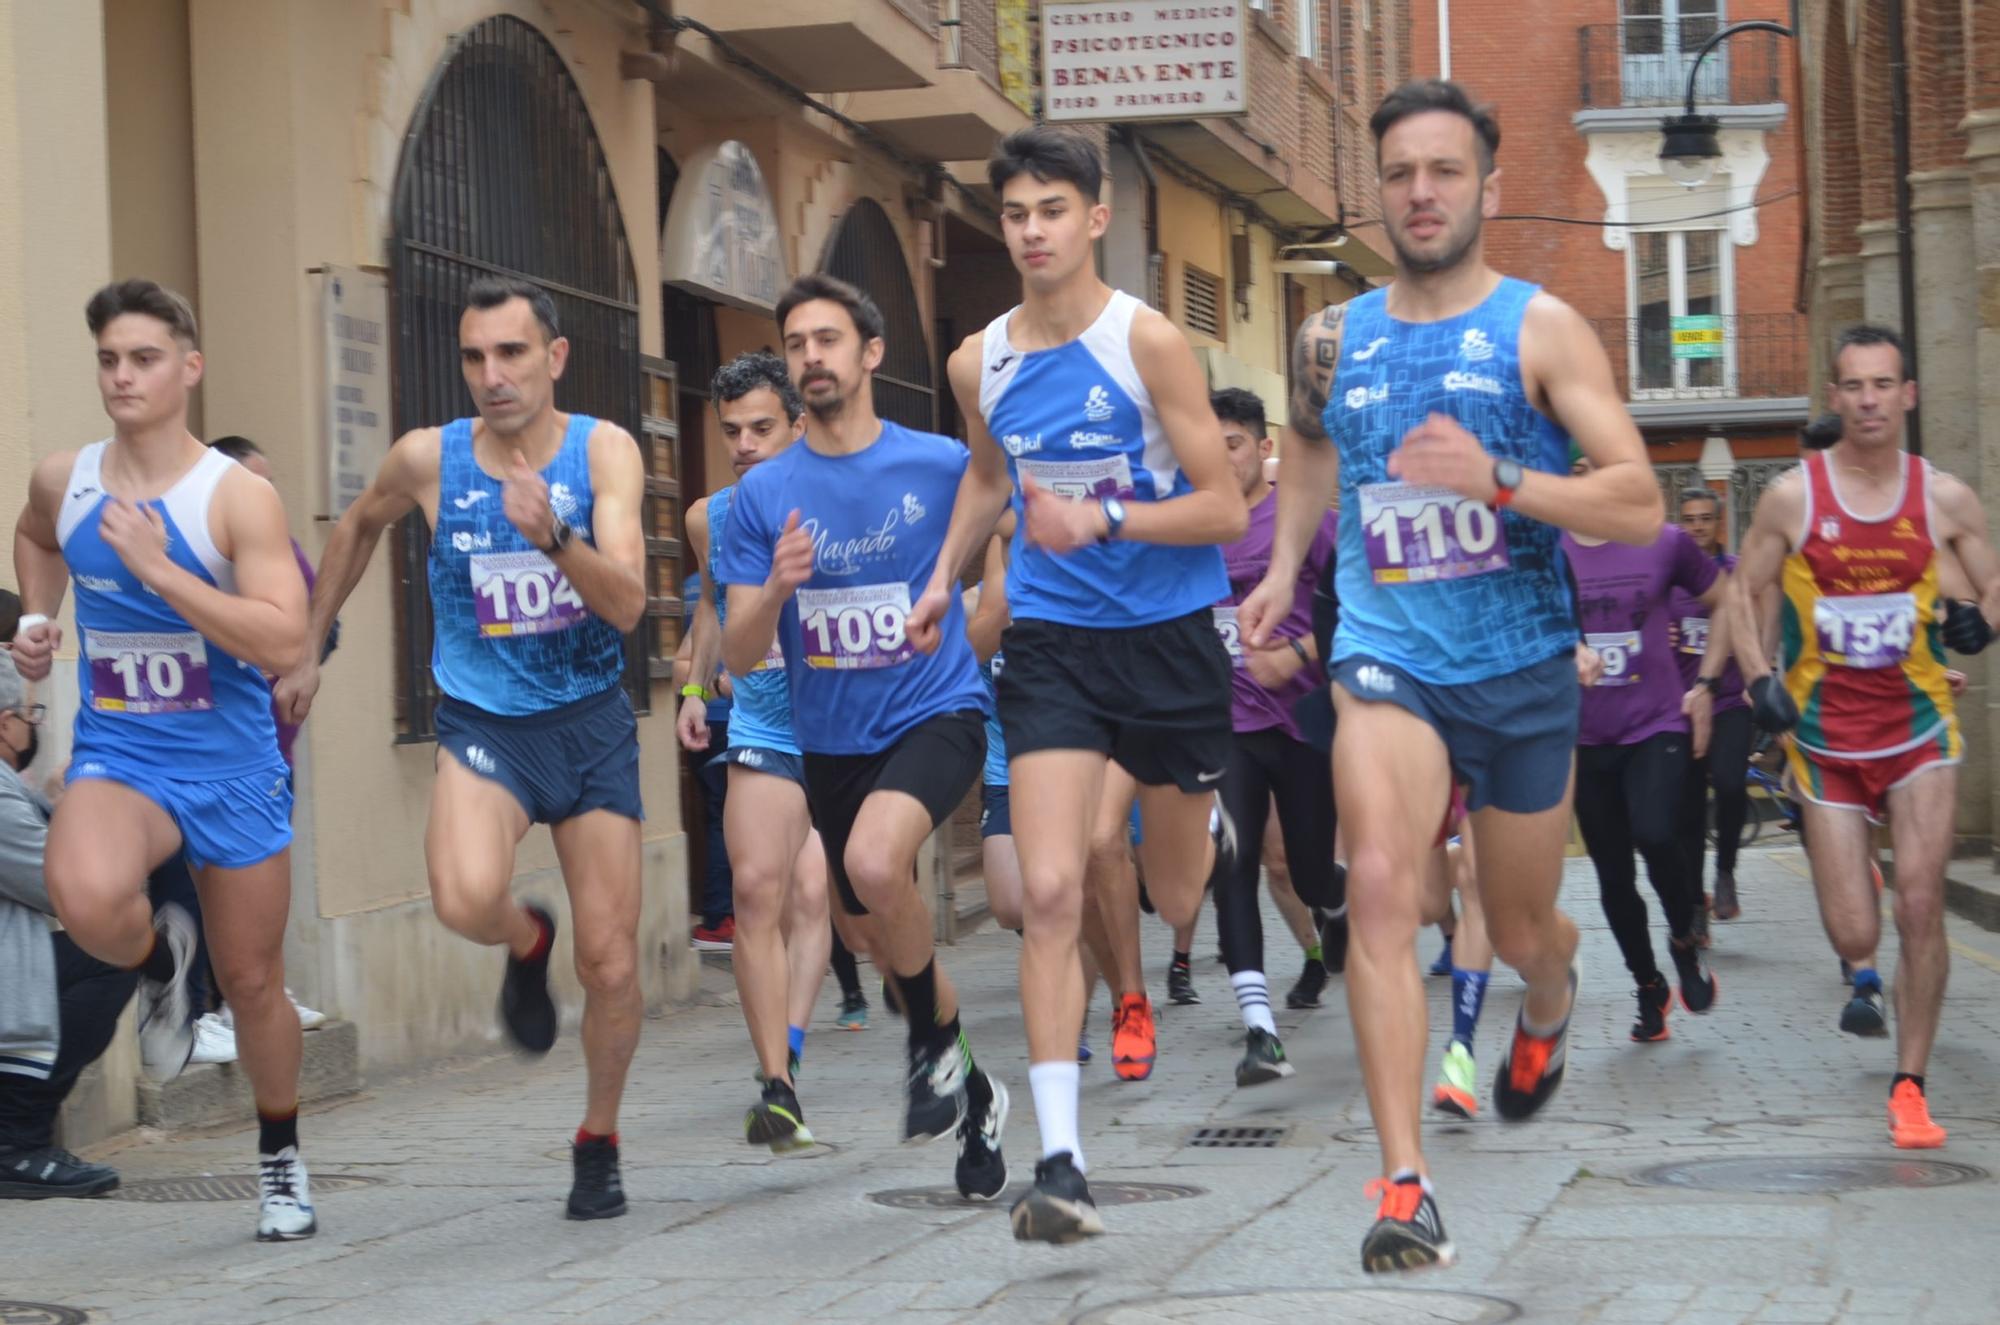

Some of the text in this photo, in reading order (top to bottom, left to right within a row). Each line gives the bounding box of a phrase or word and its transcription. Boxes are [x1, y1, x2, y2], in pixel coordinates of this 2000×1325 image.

[1051, 6, 1236, 25] CENTRO MEDICO
[1051, 32, 1236, 54] PSICOTECNICO
[1053, 61, 1237, 86] BENAVENTE
[1053, 89, 1238, 109] PISO PRIMERO A
[1371, 500, 1497, 564] 110
[481, 572, 584, 620] 104
[807, 604, 906, 654] 109
[1820, 613, 1912, 653] 154
[112, 652, 184, 698] 10
